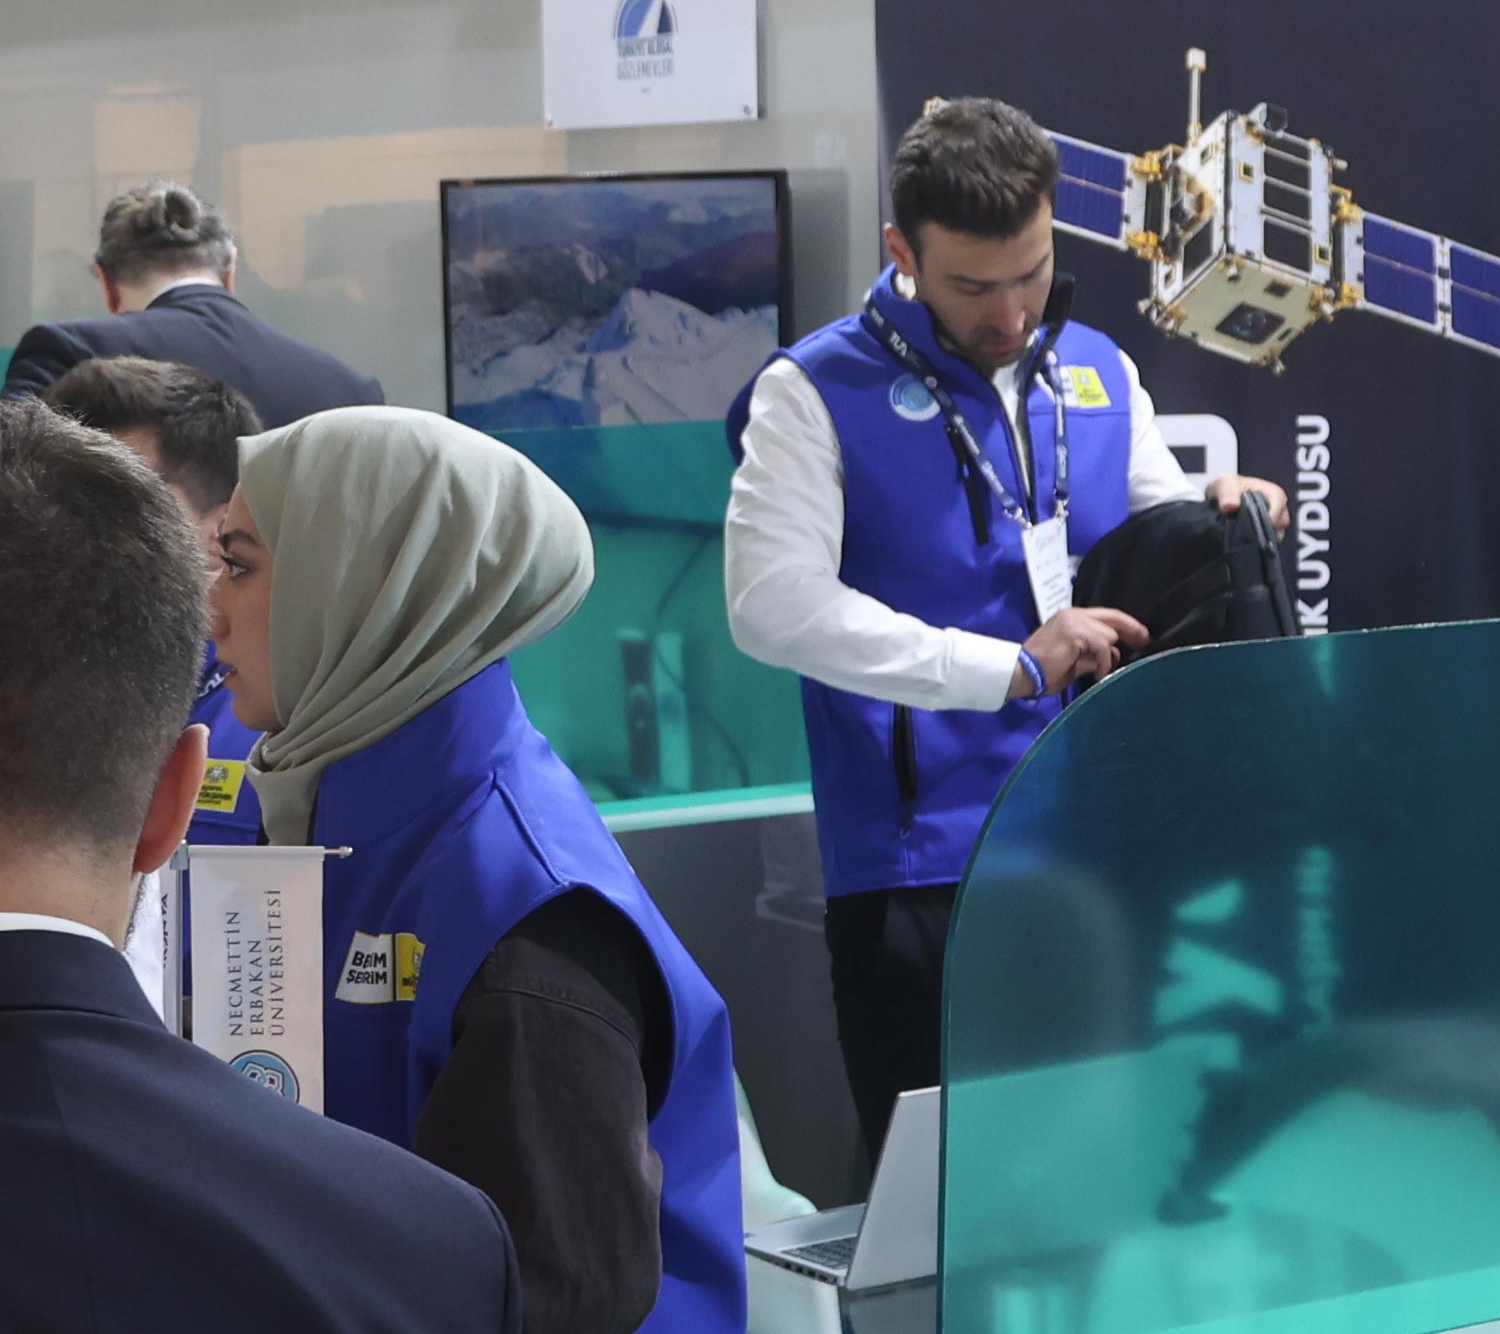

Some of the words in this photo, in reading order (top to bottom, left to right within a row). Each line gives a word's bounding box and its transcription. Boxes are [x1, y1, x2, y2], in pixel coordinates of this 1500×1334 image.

[1295, 414, 1331, 590] UYDUSU
[224, 911, 243, 1036] NECMETTİN
[247, 939, 264, 1036] ERBAKAN
[264, 890, 285, 1036] ÜNİVERSİTESİ
